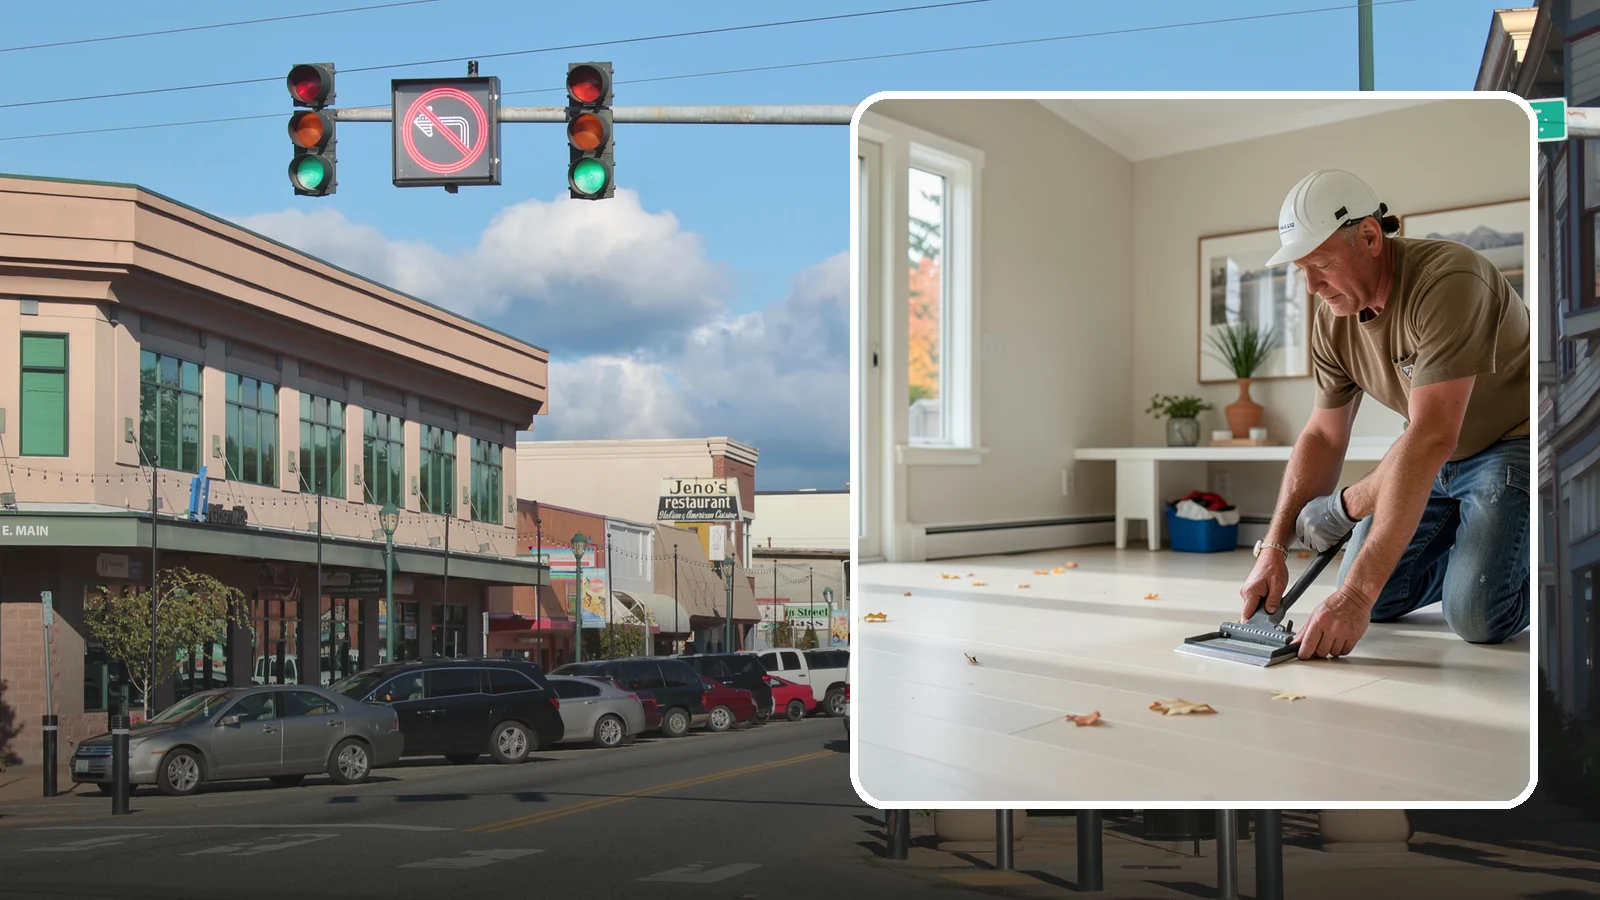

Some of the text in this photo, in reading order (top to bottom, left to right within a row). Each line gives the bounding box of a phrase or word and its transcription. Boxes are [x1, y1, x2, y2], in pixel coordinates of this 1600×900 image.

[669, 480, 728, 494] Jeno's
[665, 496, 731, 509] restaurant
[658, 510, 682, 520] Italian
[686, 509, 714, 520] American
[715, 509, 738, 520] Cuisine
[2, 525, 49, 536] E. MAIN
[797, 607, 829, 617] Street
